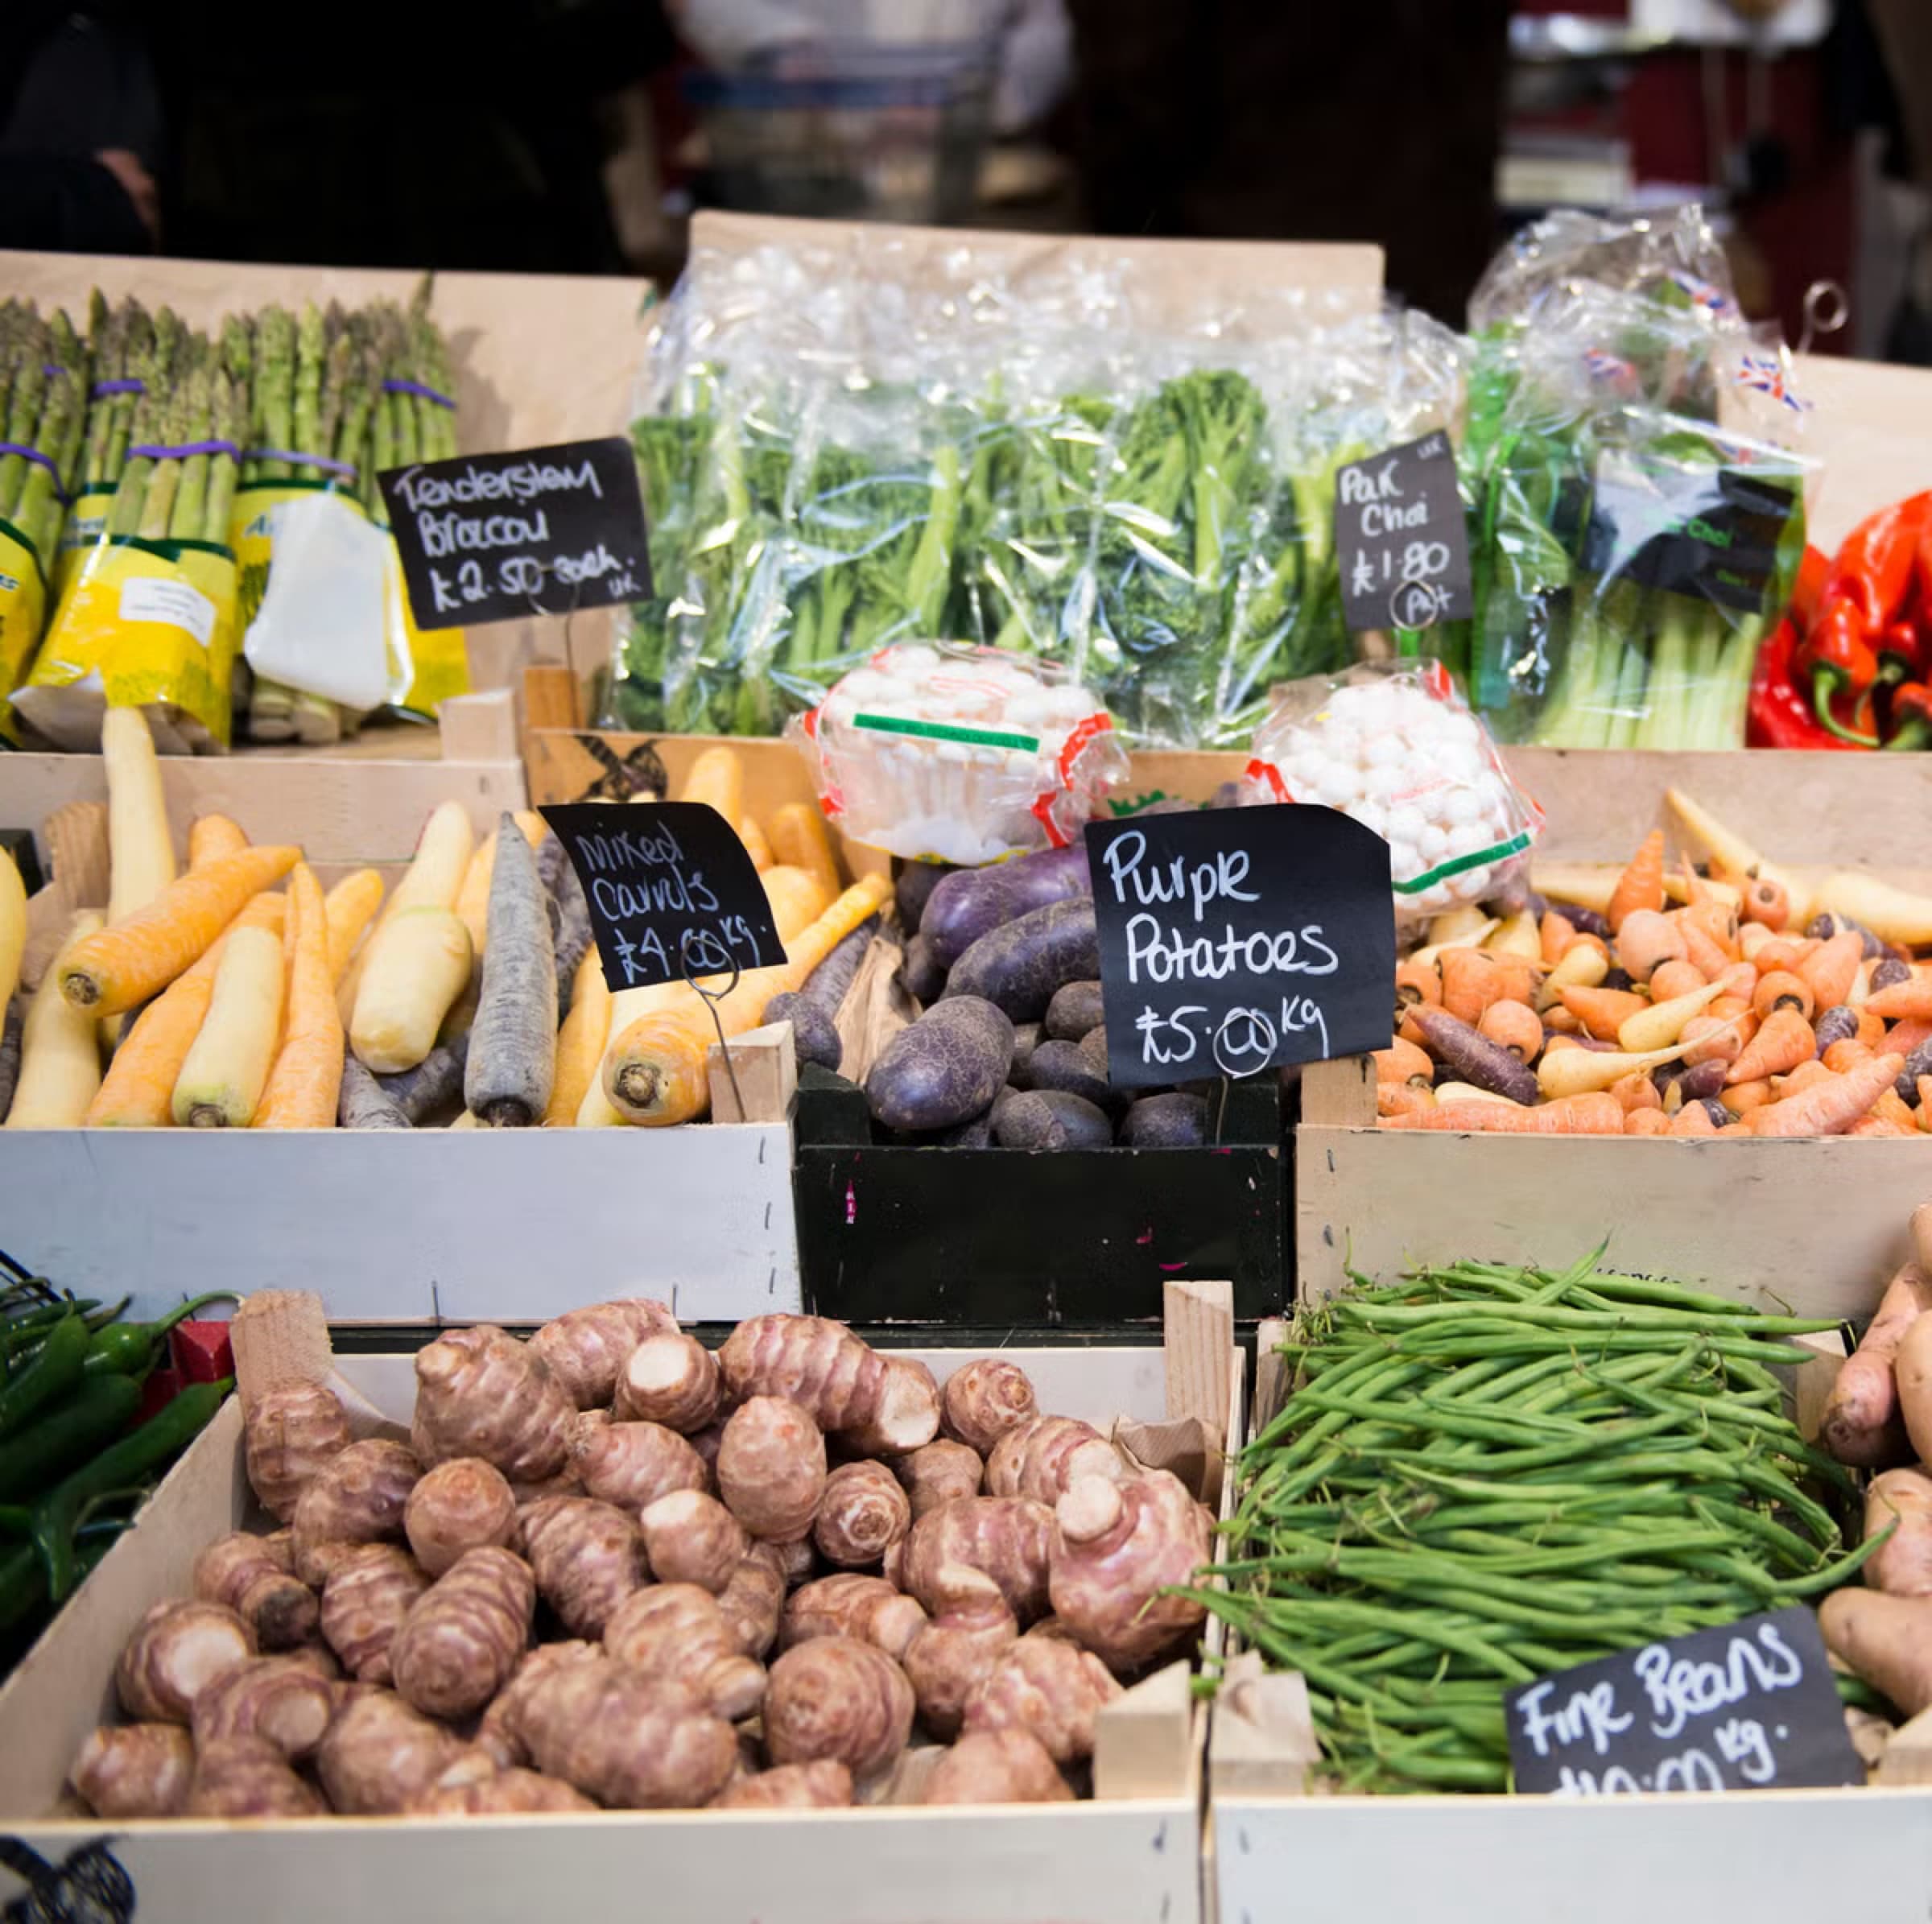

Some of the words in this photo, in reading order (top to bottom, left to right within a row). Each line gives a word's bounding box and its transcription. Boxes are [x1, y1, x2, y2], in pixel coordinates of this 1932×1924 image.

[429, 555, 545, 613] £2.50
[1351, 540, 1451, 597] £1.80
[1102, 829, 1262, 922] Purple
[613, 927, 729, 985] £4.00
[1125, 912, 1339, 984] Potatoes
[1135, 1005, 1278, 1063] £5.00
[1515, 1679, 1634, 1757] Fine
